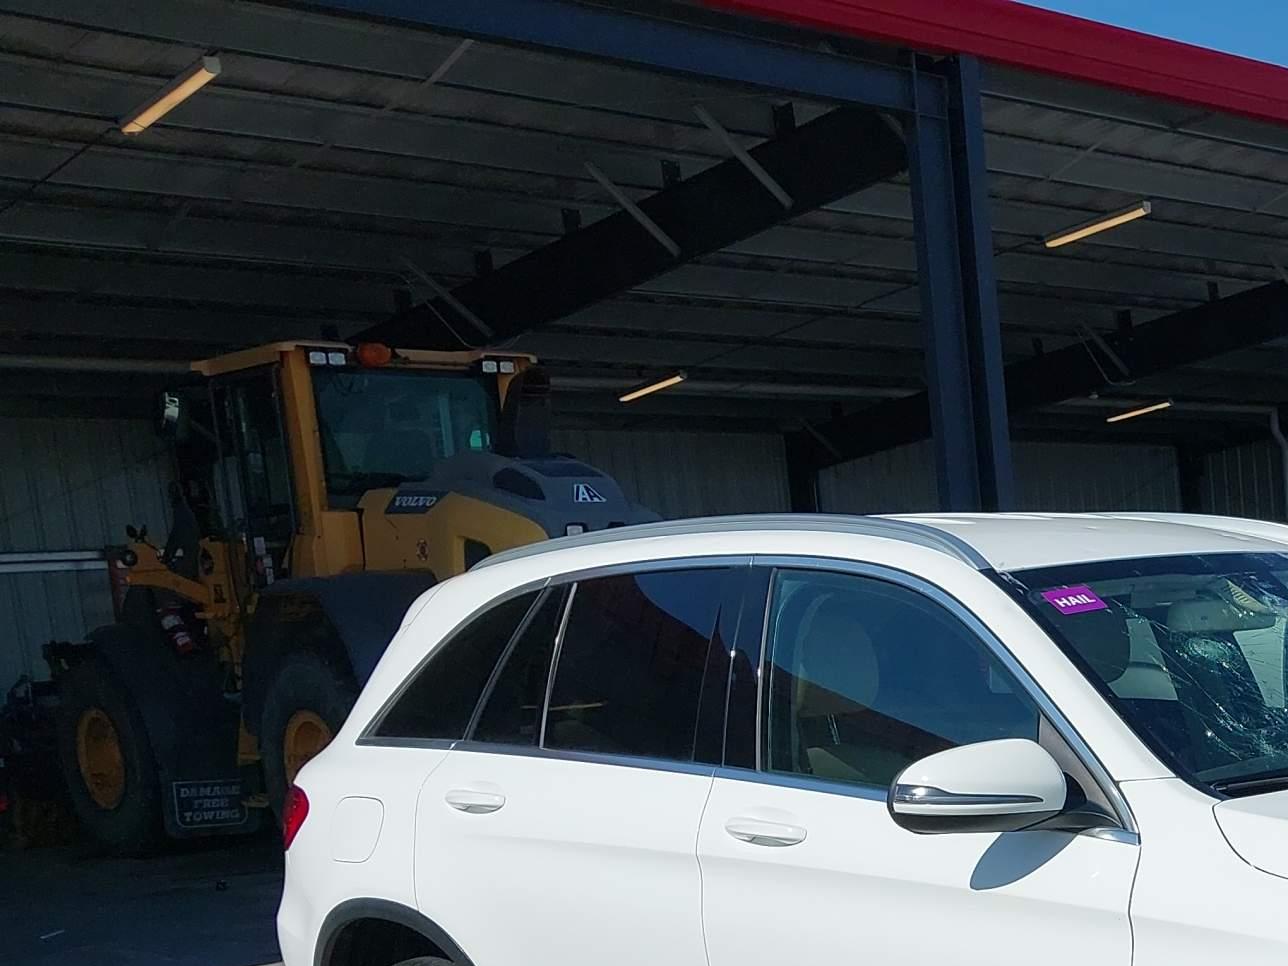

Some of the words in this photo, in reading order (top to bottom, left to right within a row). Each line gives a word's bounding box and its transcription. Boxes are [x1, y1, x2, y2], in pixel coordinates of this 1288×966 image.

[394, 495, 438, 508] VOLVO
[1053, 593, 1097, 608] HAIL
[183, 809, 241, 822] TOWING
